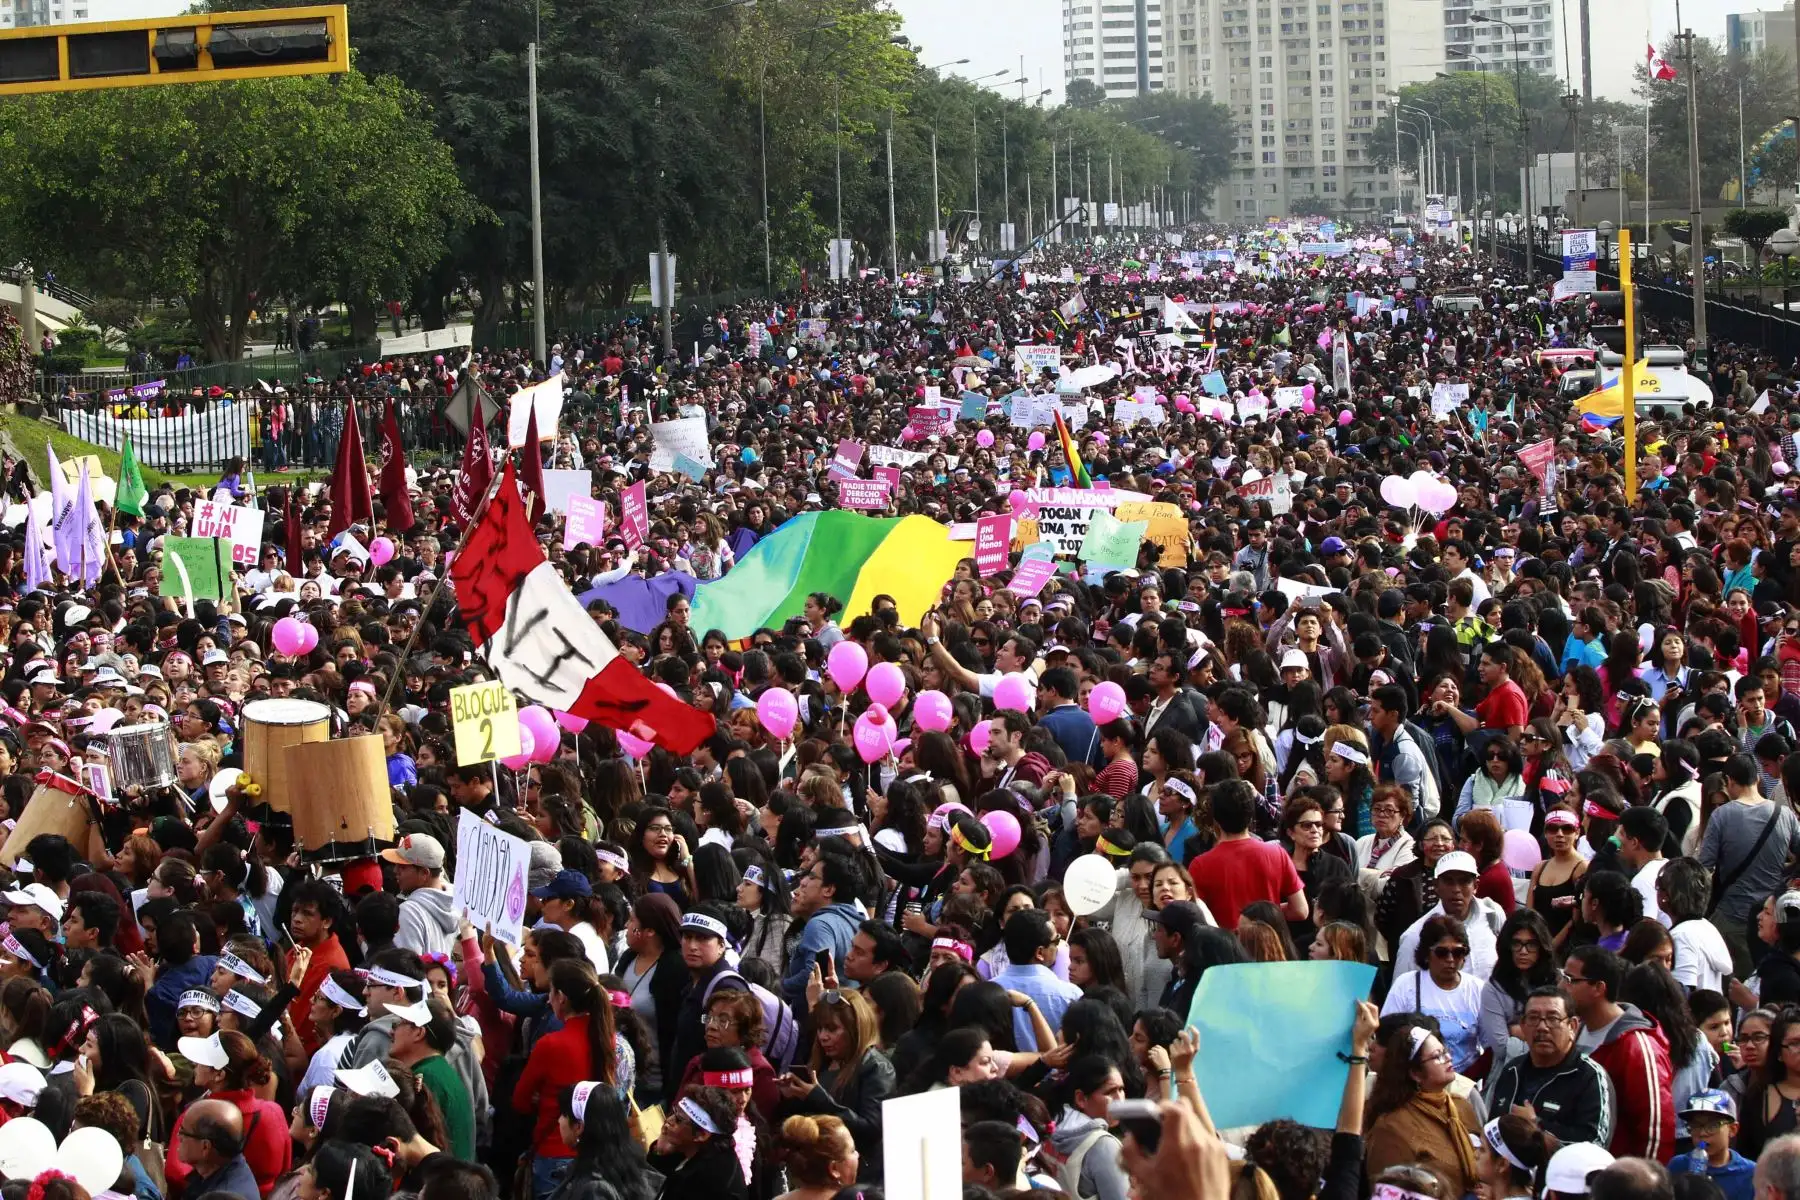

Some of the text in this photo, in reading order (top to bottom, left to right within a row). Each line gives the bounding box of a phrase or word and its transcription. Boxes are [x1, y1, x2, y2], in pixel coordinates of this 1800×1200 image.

[842, 482, 887, 491] NADIE TIENE
[846, 490, 880, 498] DERECHO
[851, 497, 884, 505] TOCARTE
[219, 507, 238, 525] NI
[1039, 507, 1081, 520] TOCAN
[197, 520, 232, 539] UNA
[980, 524, 994, 533] #Ni
[979, 533, 994, 541] Una
[978, 540, 1003, 551] Menos
[479, 718, 496, 760] 2
